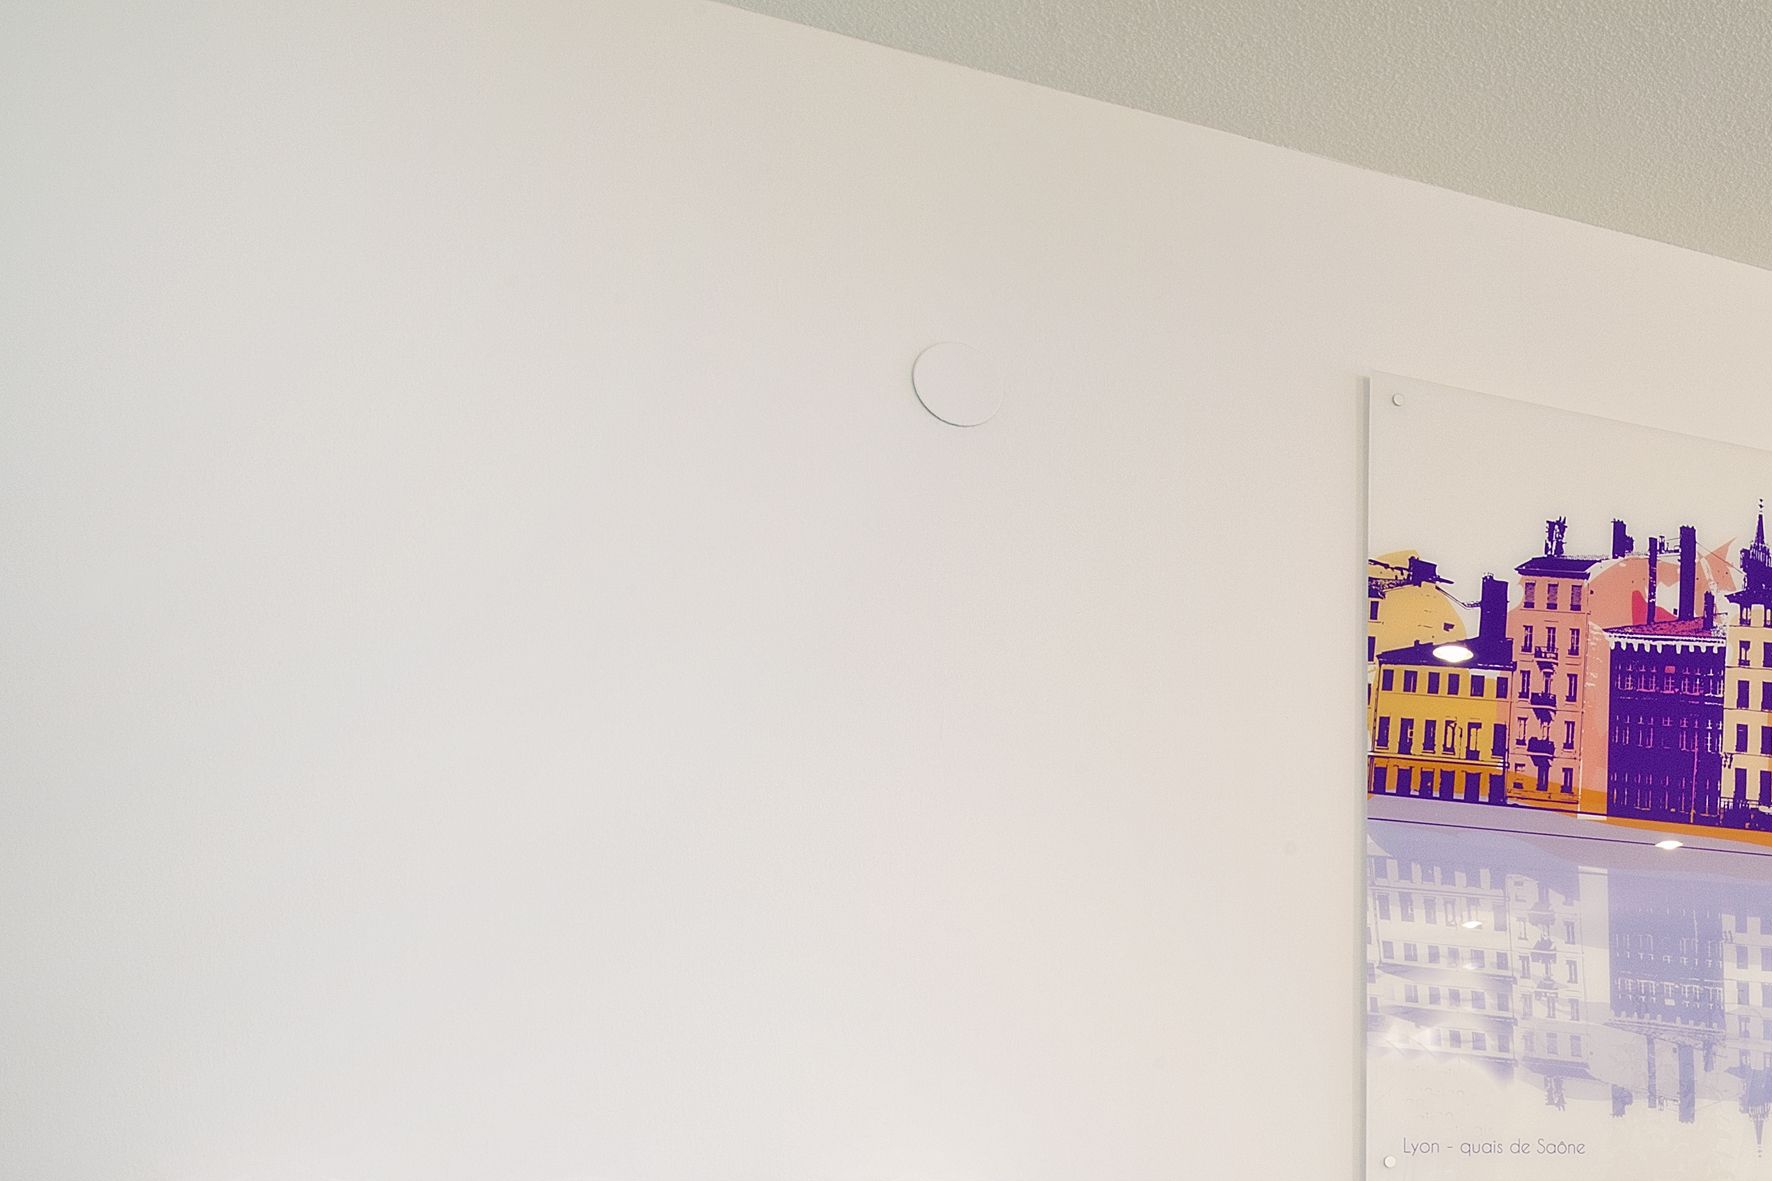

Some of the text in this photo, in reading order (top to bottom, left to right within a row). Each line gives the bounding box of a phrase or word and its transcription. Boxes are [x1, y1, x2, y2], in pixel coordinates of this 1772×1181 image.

[1403, 1137, 1440, 1156] Lyon
[1460, 1140, 1503, 1156] quais
[1509, 1138, 1530, 1154] de
[1537, 1138, 1585, 1155] Saône
